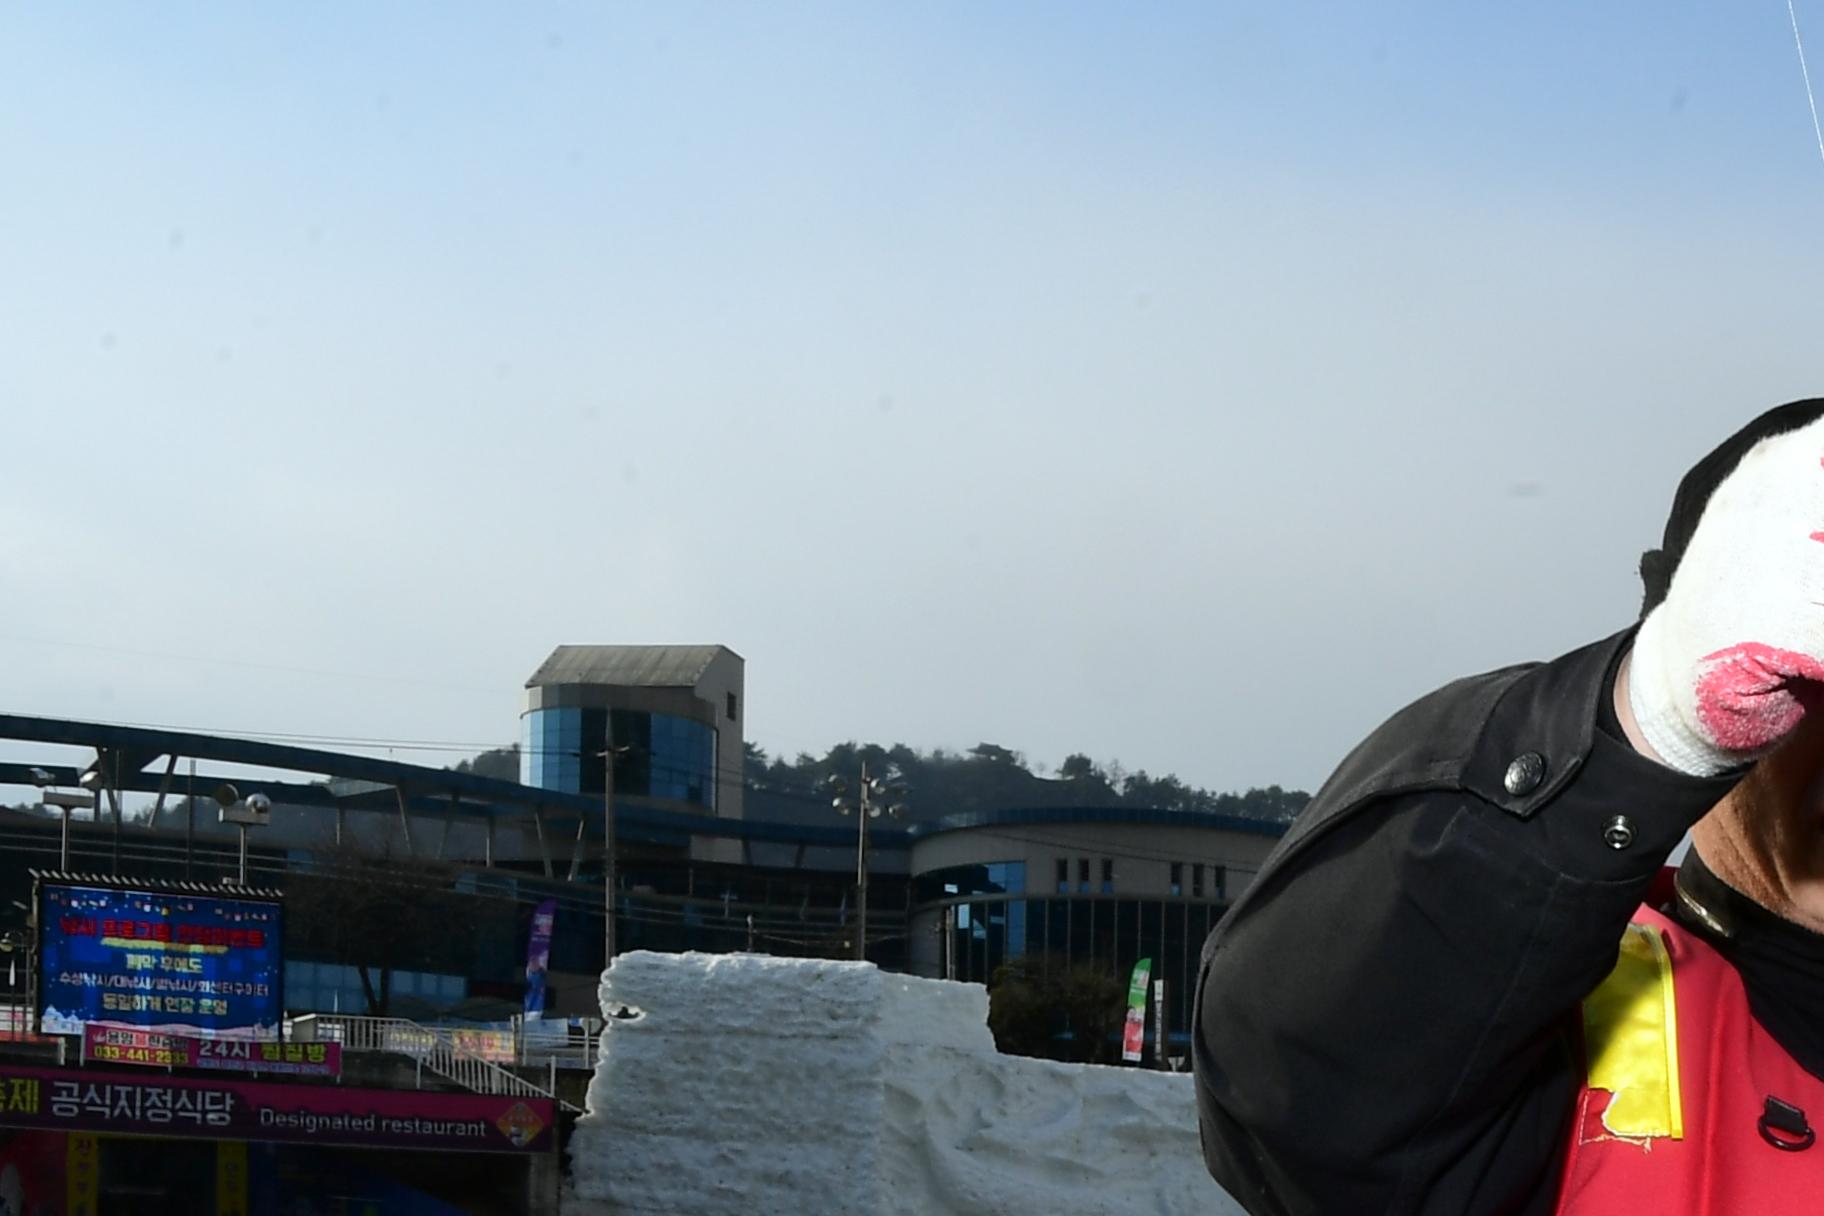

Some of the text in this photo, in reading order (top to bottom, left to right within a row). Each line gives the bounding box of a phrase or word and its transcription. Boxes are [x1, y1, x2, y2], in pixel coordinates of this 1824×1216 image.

[102, 919, 171, 941] 프로그램
[161, 955, 203, 973] 후에도
[102, 994, 228, 1015] 동일하게 연장 운영
[199, 1040, 251, 1059] 24시
[0, 1078, 235, 1126] 제 공식지정식당
[259, 1106, 487, 1138] Designated restaurant
